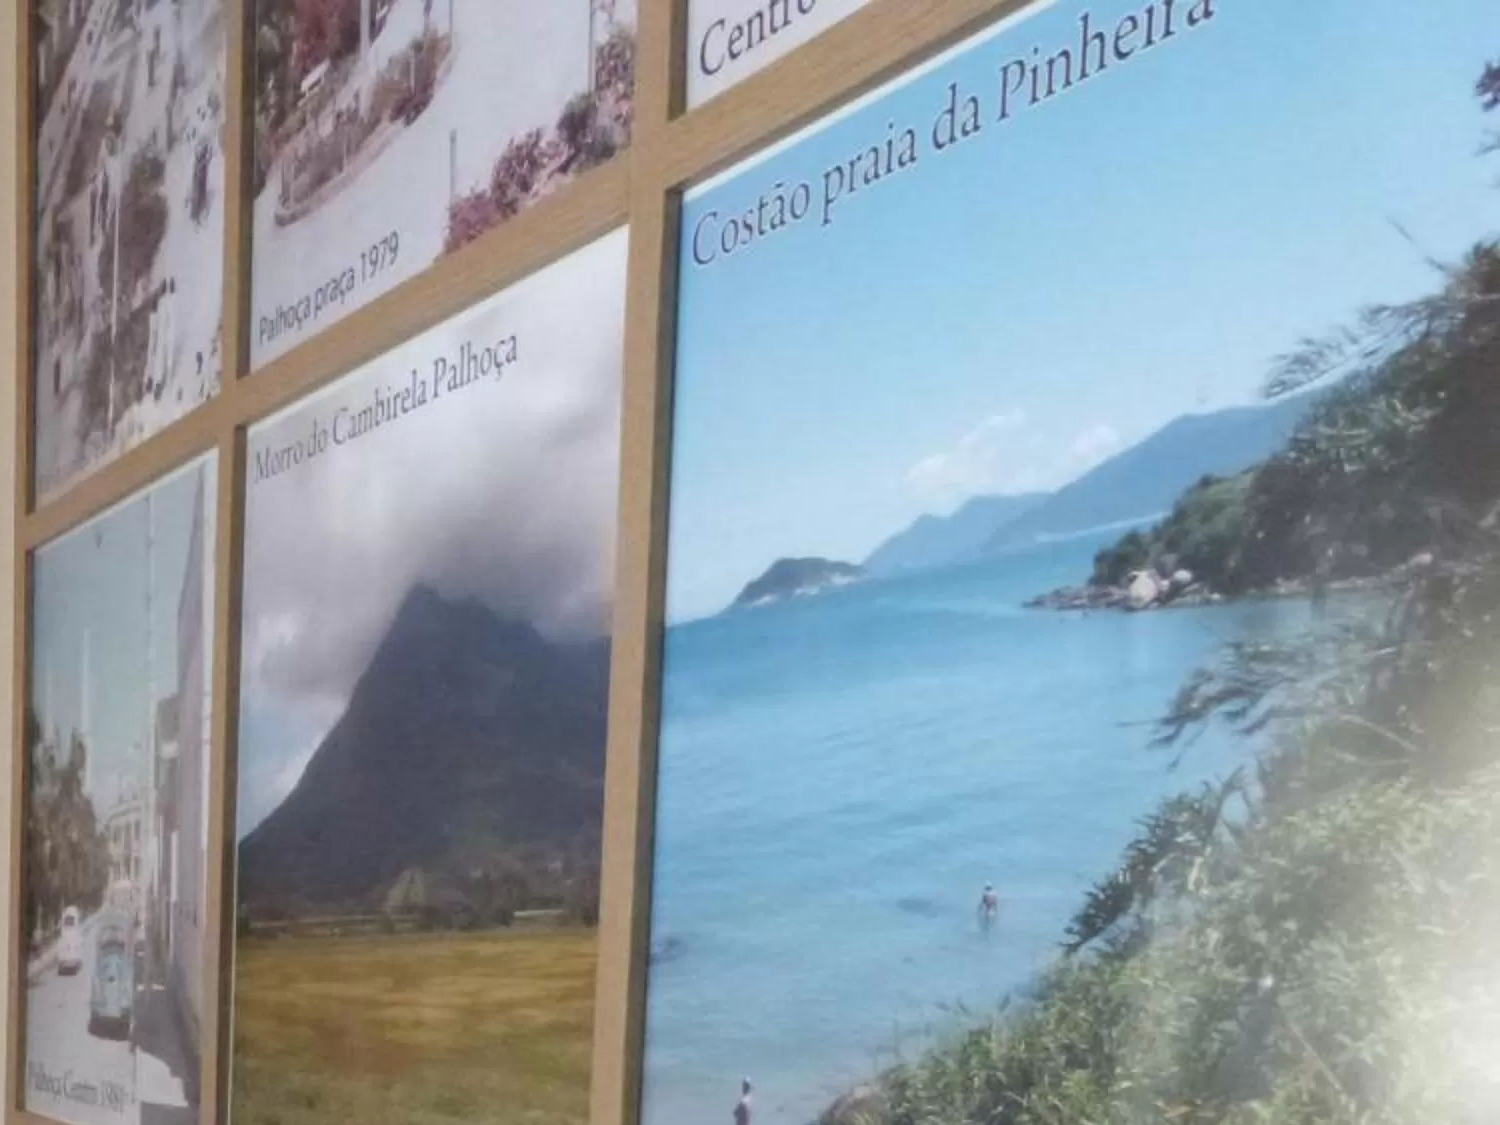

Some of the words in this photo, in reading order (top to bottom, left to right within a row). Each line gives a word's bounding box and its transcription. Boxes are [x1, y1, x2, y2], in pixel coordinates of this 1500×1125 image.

[692, 182, 810, 266] Costão
[821, 122, 918, 226] praia
[932, 83, 981, 151] da
[258, 296, 311, 346] Palhoça
[314, 265, 356, 313] praça
[360, 229, 399, 283] 1979
[253, 438, 304, 485] Morro
[307, 416, 328, 459] do
[332, 368, 427, 446] Cambirela
[431, 334, 517, 401] Palhoça
